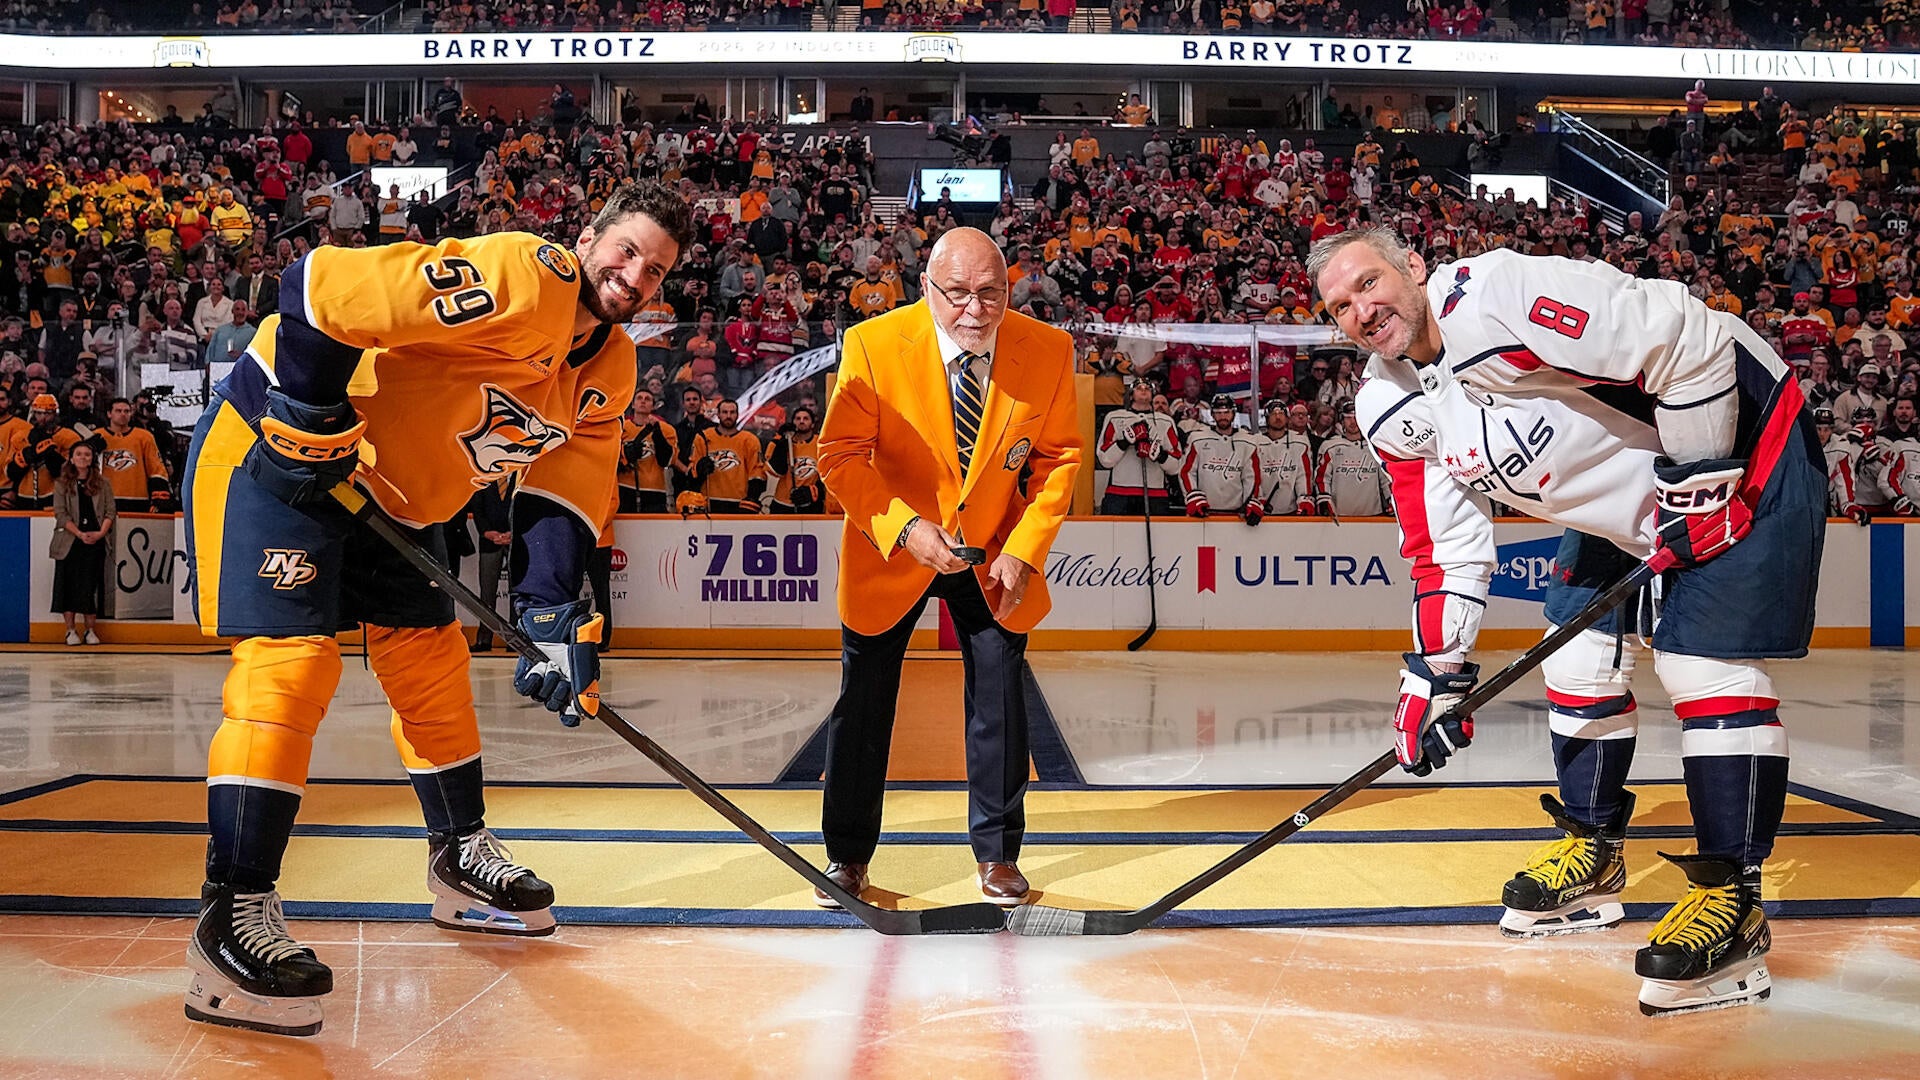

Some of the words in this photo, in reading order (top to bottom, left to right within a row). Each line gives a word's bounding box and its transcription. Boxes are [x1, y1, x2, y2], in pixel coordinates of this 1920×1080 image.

[425, 39, 532, 58] BARRY
[551, 38, 654, 56] TROTZ
[912, 39, 954, 56] GOLDEN
[1184, 41, 1291, 60] BARRY
[1310, 43, 1413, 64] TROTZ
[423, 256, 497, 327] 59
[1529, 296, 1590, 340] 8
[577, 387, 609, 423] C
[1461, 380, 1495, 407] C
[270, 433, 360, 460] CCM
[1404, 428, 1436, 450] TikTok
[258, 548, 317, 590] NP
[1046, 550, 1182, 588] Michelob
[1235, 555, 1392, 587] ULTRA
[611, 591, 628, 600] SAT
[702, 579, 818, 602] MILLION
[533, 612, 557, 622] CCM
[460, 880, 493, 901] BAUER
[219, 947, 250, 977] BAUER
